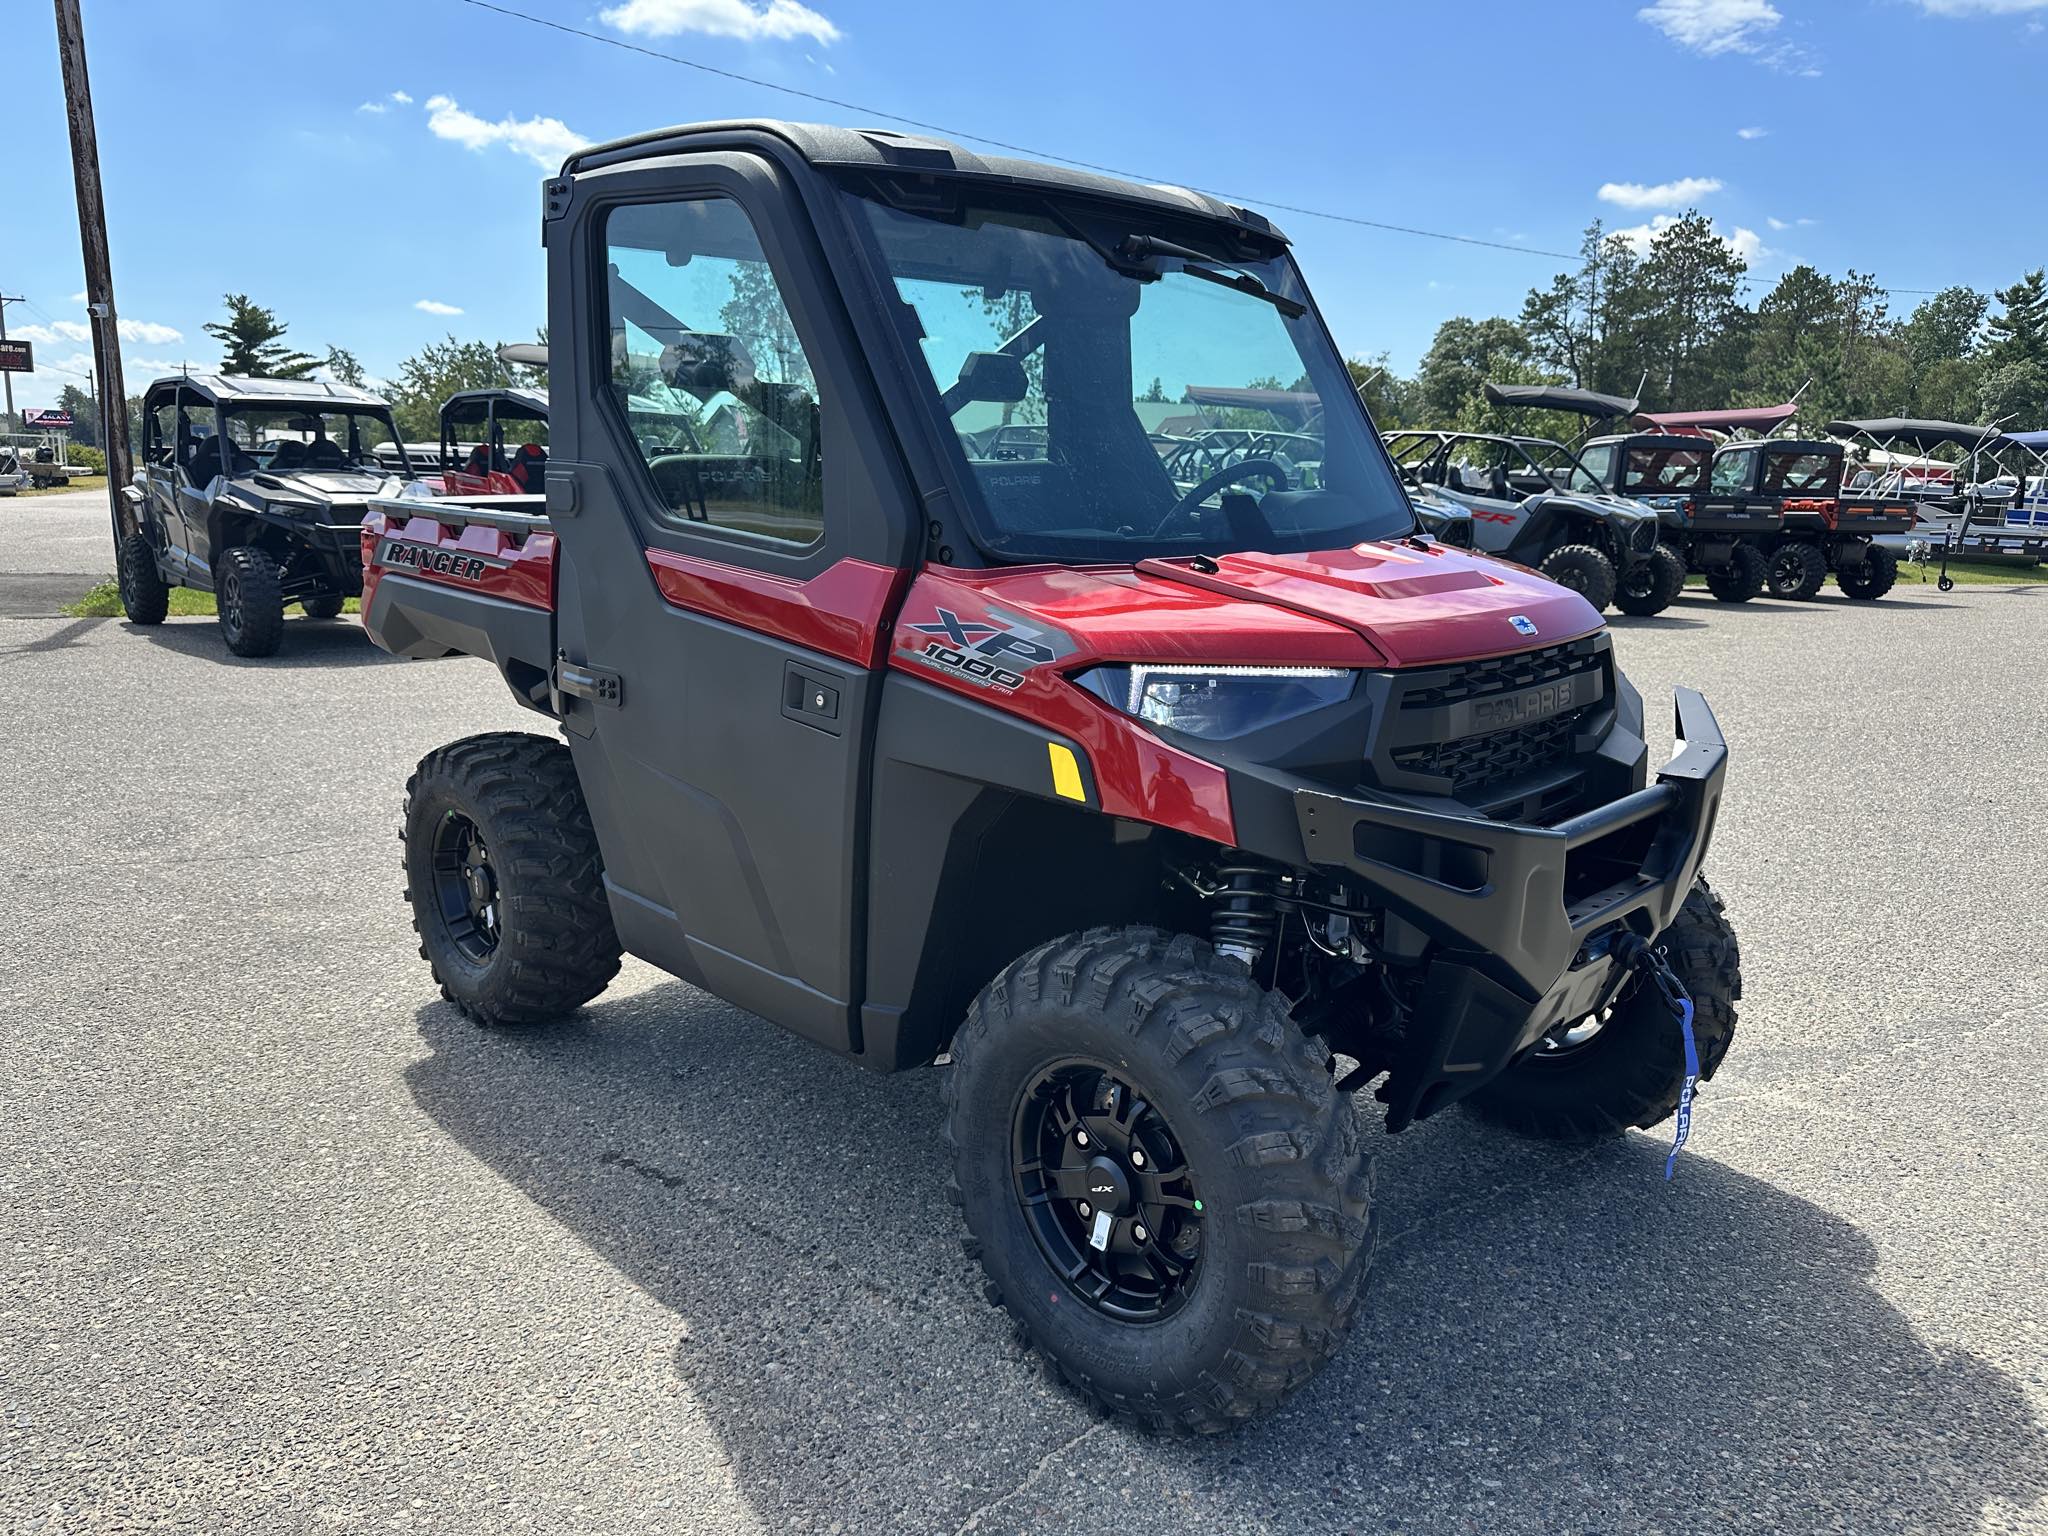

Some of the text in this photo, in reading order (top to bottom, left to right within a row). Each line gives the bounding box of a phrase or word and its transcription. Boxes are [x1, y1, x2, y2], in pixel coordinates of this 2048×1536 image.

[386, 542, 486, 582] RANGER
[903, 605, 1057, 665] XP
[920, 657, 1014, 696] DUAL OVERHEAD CAM
[924, 641, 1027, 691] 1000
[1474, 681, 1573, 728] POLARIS
[1669, 1075, 1696, 1157] POLARIS
